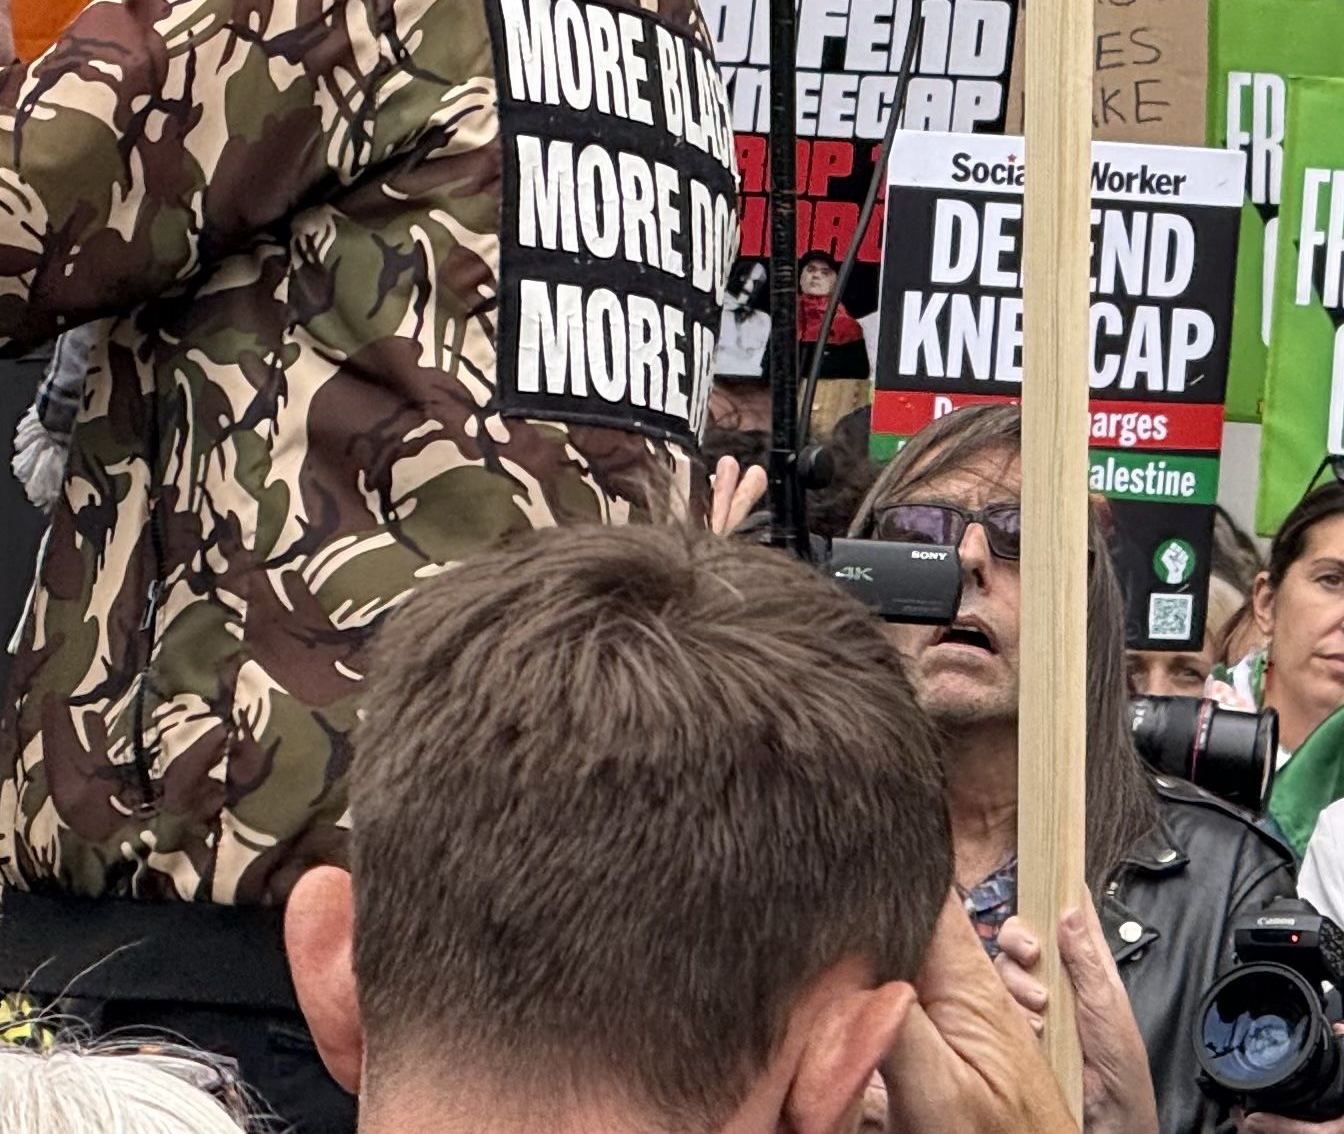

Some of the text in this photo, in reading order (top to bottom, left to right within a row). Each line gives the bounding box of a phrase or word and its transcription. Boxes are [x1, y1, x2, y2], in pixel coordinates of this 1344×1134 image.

[951, 152, 1025, 187] Socia
[515, 133, 686, 279] MORE
[930, 197, 1196, 299] DEND
[516, 277, 689, 420] MORE
[898, 289, 1215, 393] KNECAP
[1088, 456, 1197, 497] alestine
[834, 566, 875, 582] 4K
[911, 550, 948, 562] SONY
[1256, 916, 1296, 927] Canon
